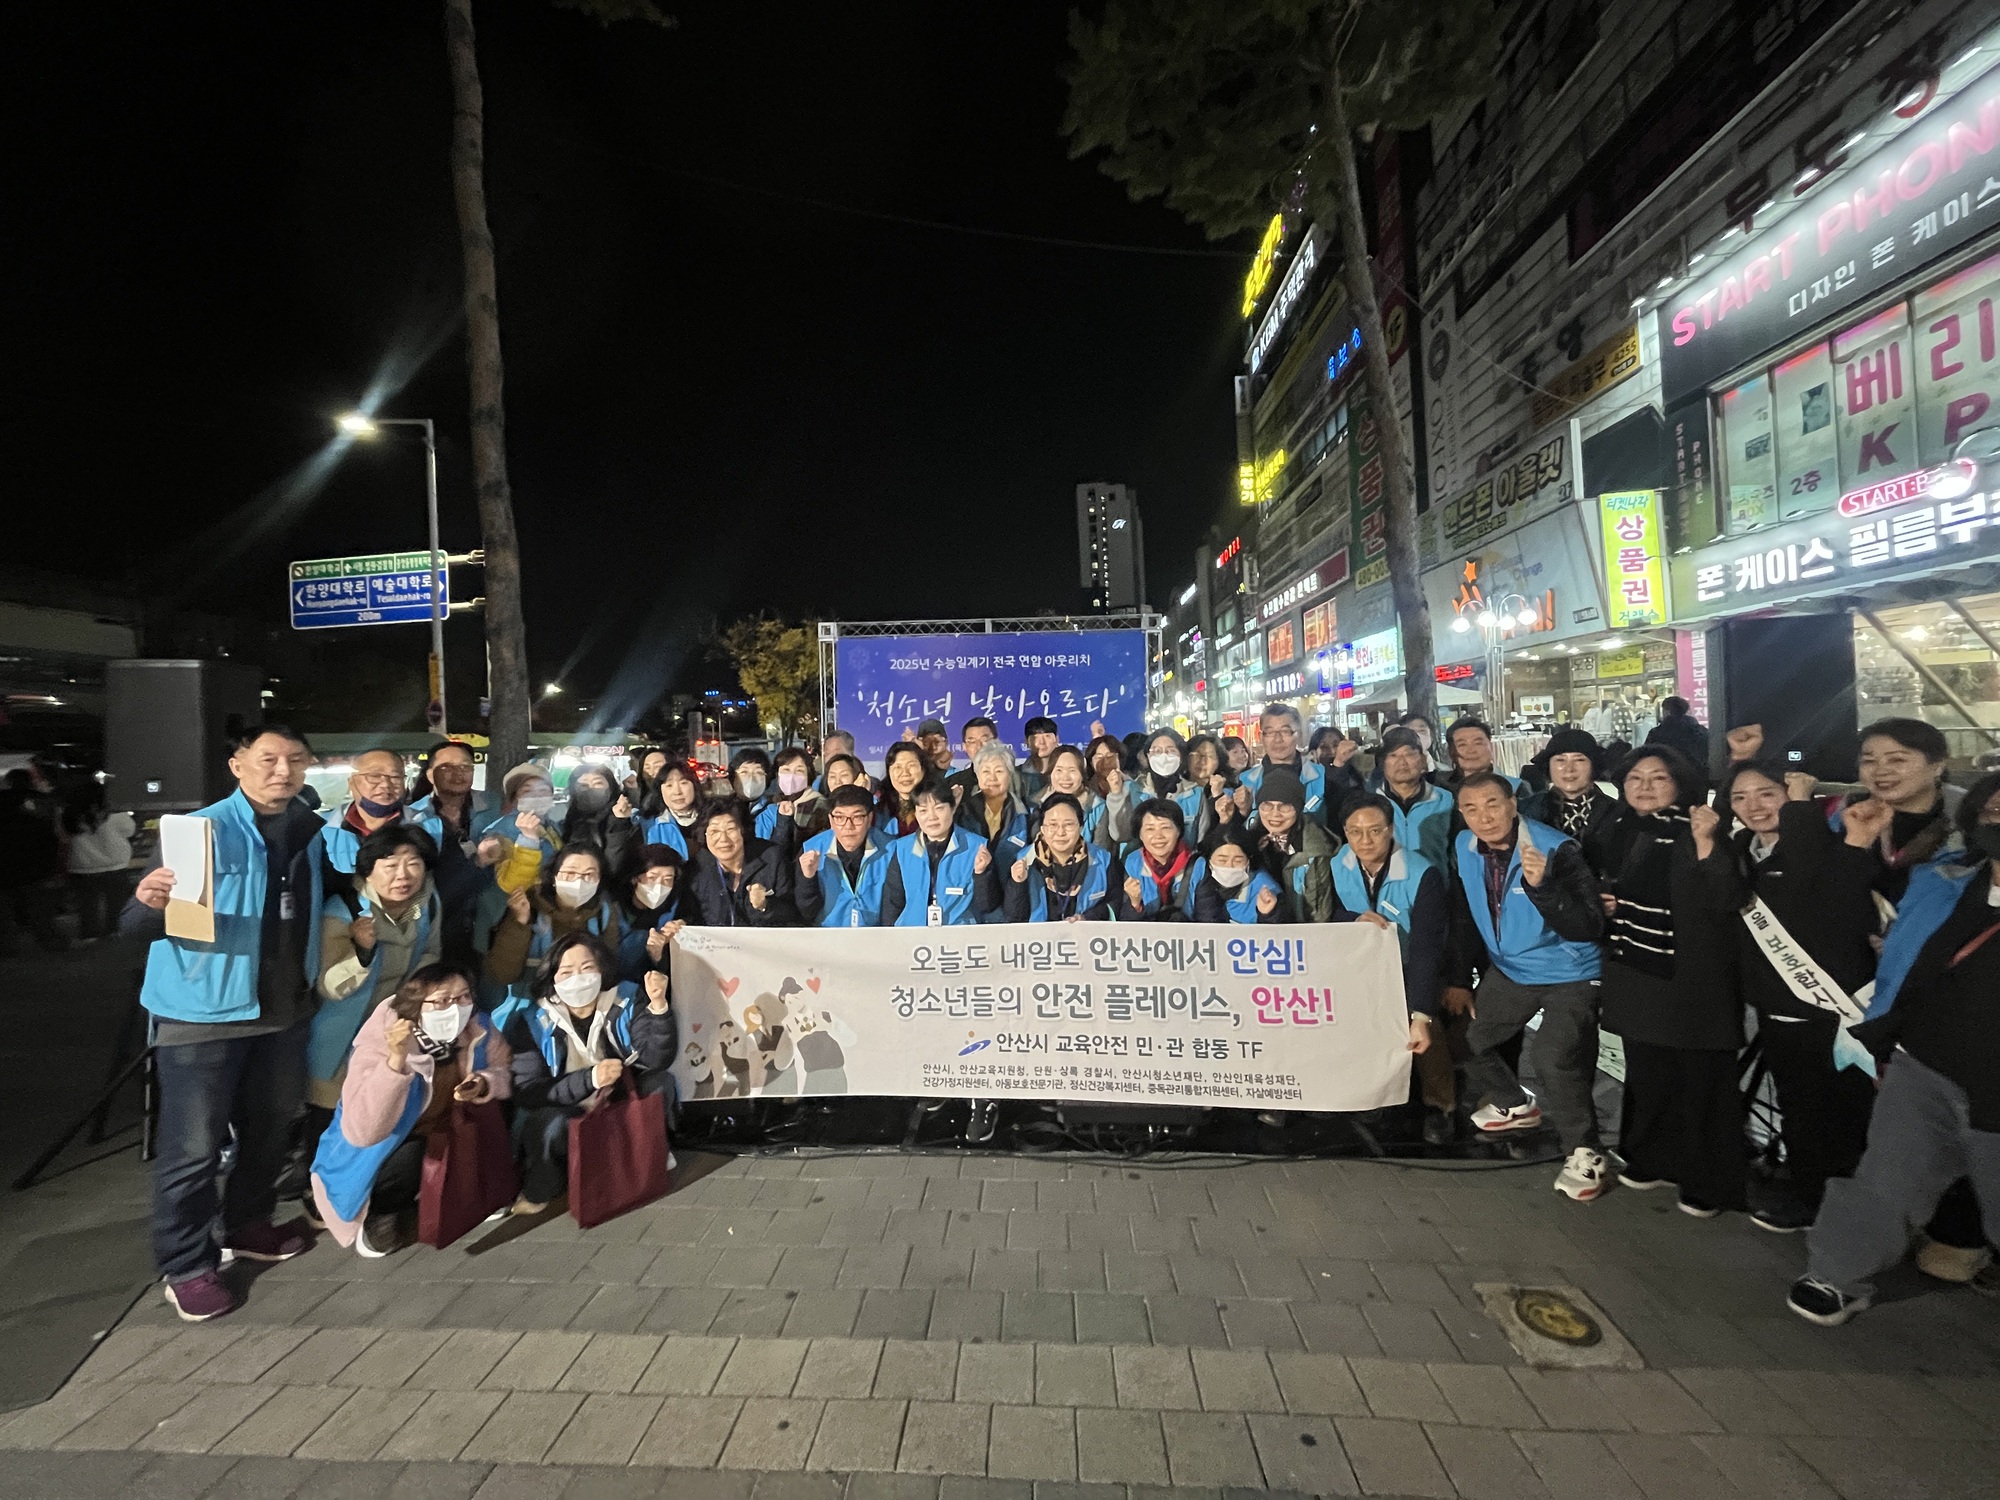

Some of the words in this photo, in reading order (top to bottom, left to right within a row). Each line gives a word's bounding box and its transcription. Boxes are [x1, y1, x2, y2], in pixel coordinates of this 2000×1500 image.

[1672, 231, 1800, 347] START
[1789, 261, 1856, 317] 디자인
[1871, 236, 1895, 270] 폰
[1356, 411, 1387, 560] 상품권
[1692, 440, 1704, 505] PHONE
[1790, 470, 1822, 496] 2층
[1848, 470, 1955, 513] START:B
[1616, 514, 1650, 605] 상품권
[1696, 563, 1726, 602] 폰
[1734, 536, 1836, 593] 케이스
[305, 580, 366, 599] 한양대학로
[371, 574, 433, 594] 예술대학로
[889, 657, 930, 671] 2025년
[933, 656, 990, 670] 수능일계기
[993, 656, 1016, 669] 전국
[1018, 655, 1042, 669] 연합
[1045, 653, 1091, 668] 아웃리치
[1265, 671, 1305, 697] ARTBOX
[910, 944, 990, 974] 오늘도
[1000, 941, 1080, 971] 내일도
[1089, 937, 1216, 973] 안산에서
[1226, 938, 1305, 975] 안심!
[891, 985, 1022, 1018] 청소년들의
[1032, 983, 1094, 1019] 안전
[1104, 983, 1241, 1027] 플레이스,
[1251, 986, 1335, 1025] 안산!
[996, 1033, 1048, 1053] 안산시
[1055, 1034, 1128, 1056] 교육안전
[1192, 1037, 1230, 1060] 합동
[1236, 1041, 1263, 1059] TF
[922, 1063, 955, 1075] 안산시,
[959, 1064, 1029, 1077] 안산교육지원청,
[1083, 1066, 1118, 1079] 경찰서,
[1122, 1068, 1208, 1083] 안산시청소년재단,
[1212, 1072, 1301, 1087] 안산인재육성재단,
[922, 1077, 993, 1089] 건강가정지원센터,
[995, 1078, 1067, 1091] 아동보호전문기관,
[1070, 1079, 1145, 1094] 정신건강복지센터,
[1147, 1083, 1243, 1099] 중독관리통합지원센터,
[1245, 1089, 1303, 1101] 자살예방센터
